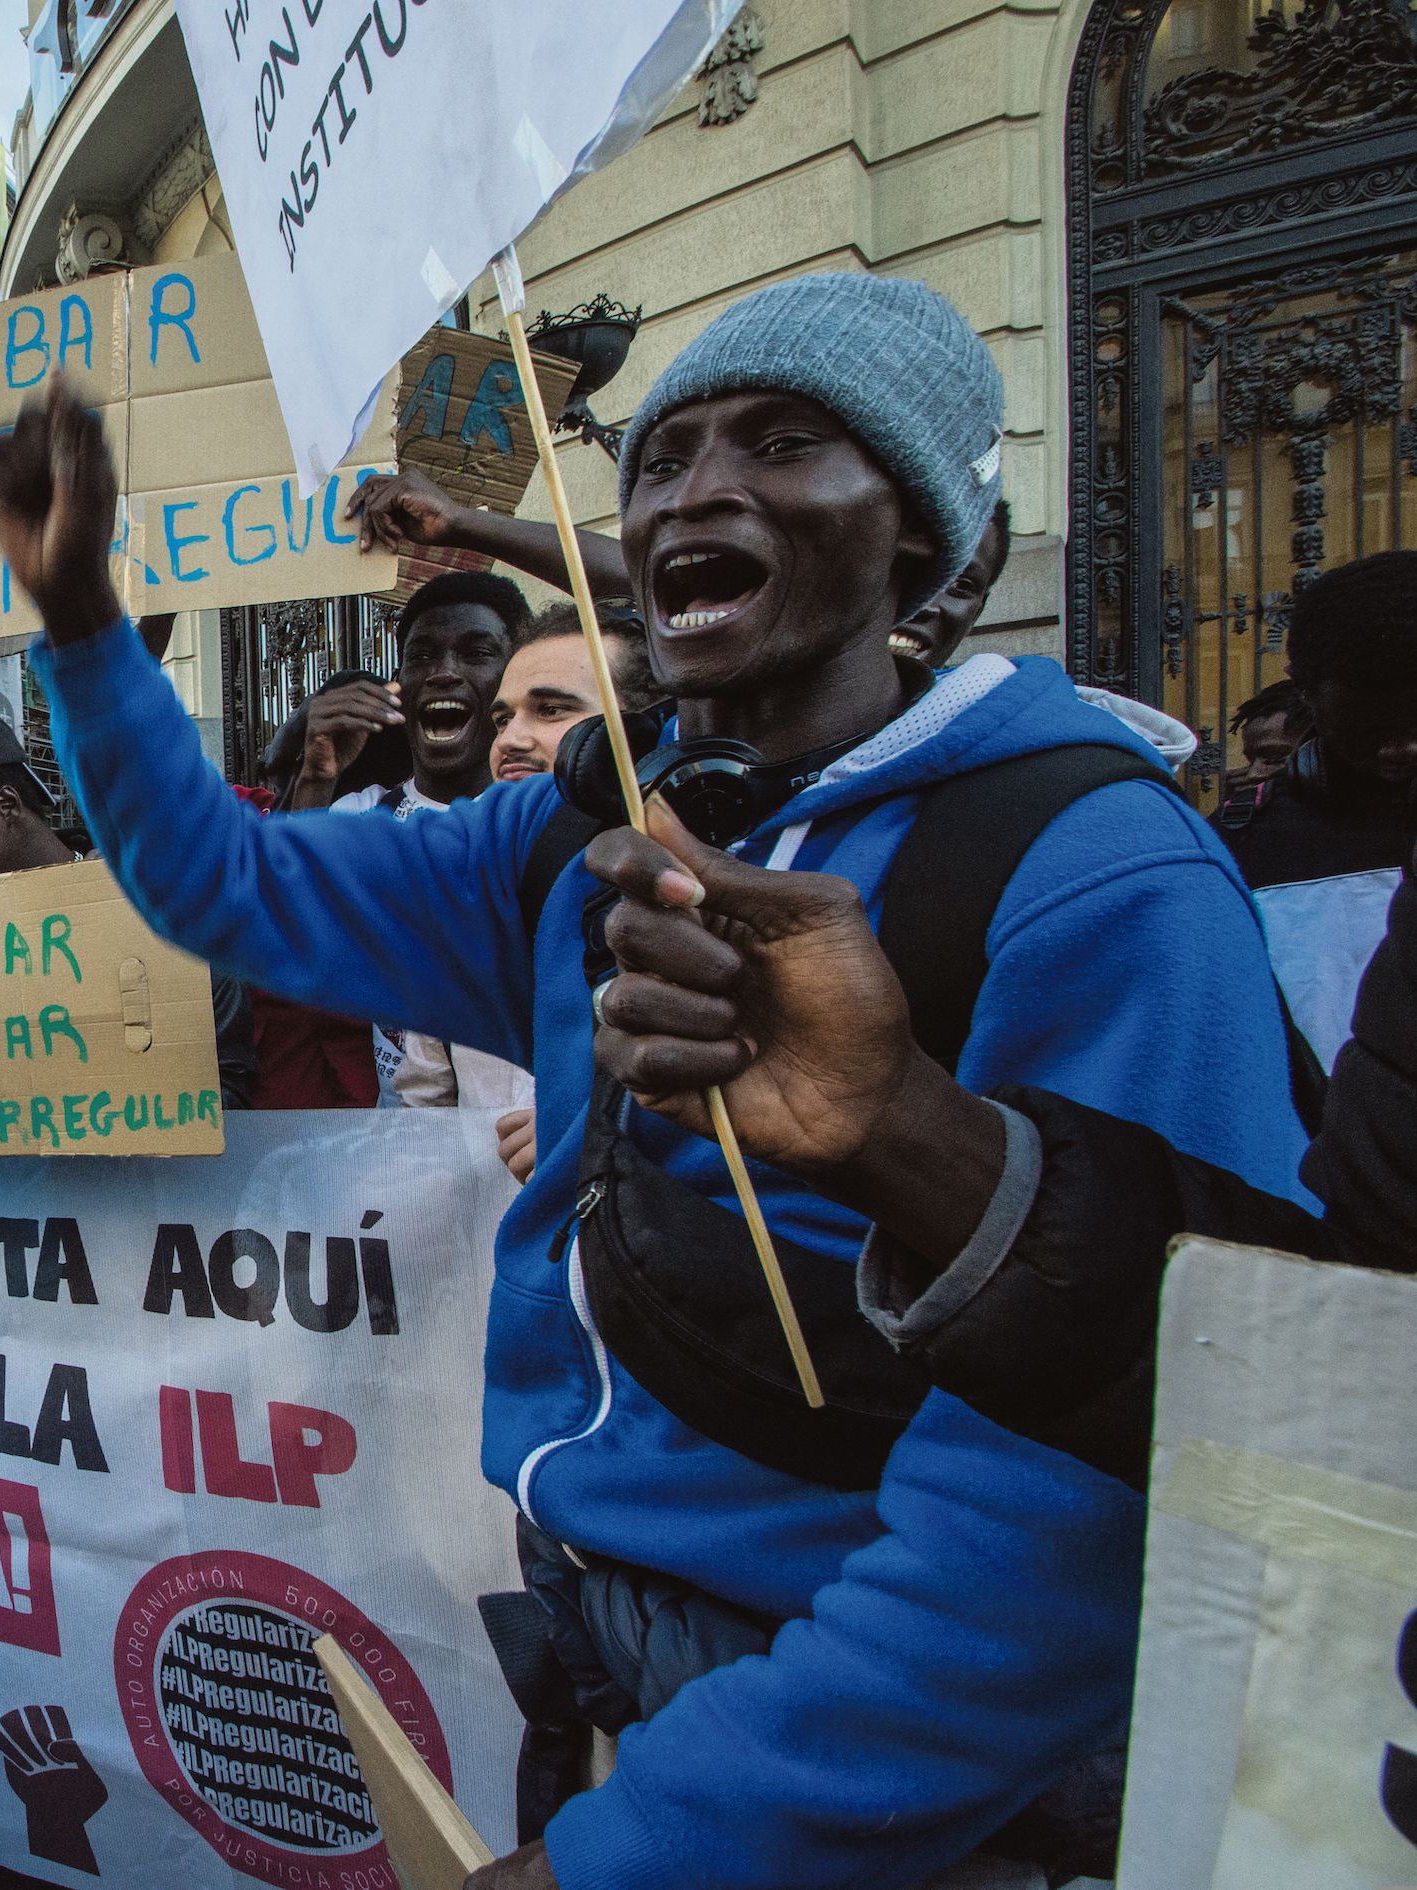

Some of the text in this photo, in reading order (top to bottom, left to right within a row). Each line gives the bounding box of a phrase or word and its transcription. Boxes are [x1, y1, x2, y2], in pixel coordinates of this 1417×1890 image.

[255, 6, 300, 162] CON
[278, 0, 428, 273] INSTITU
[142, 1209, 400, 1336] AQUÍ
[158, 1384, 358, 1509] ILP
[285, 1585, 337, 1627] 500
[394, 1700, 431, 1761] FIR
[165, 1778, 207, 1821] POR
[340, 1857, 400, 1890] SOCI
